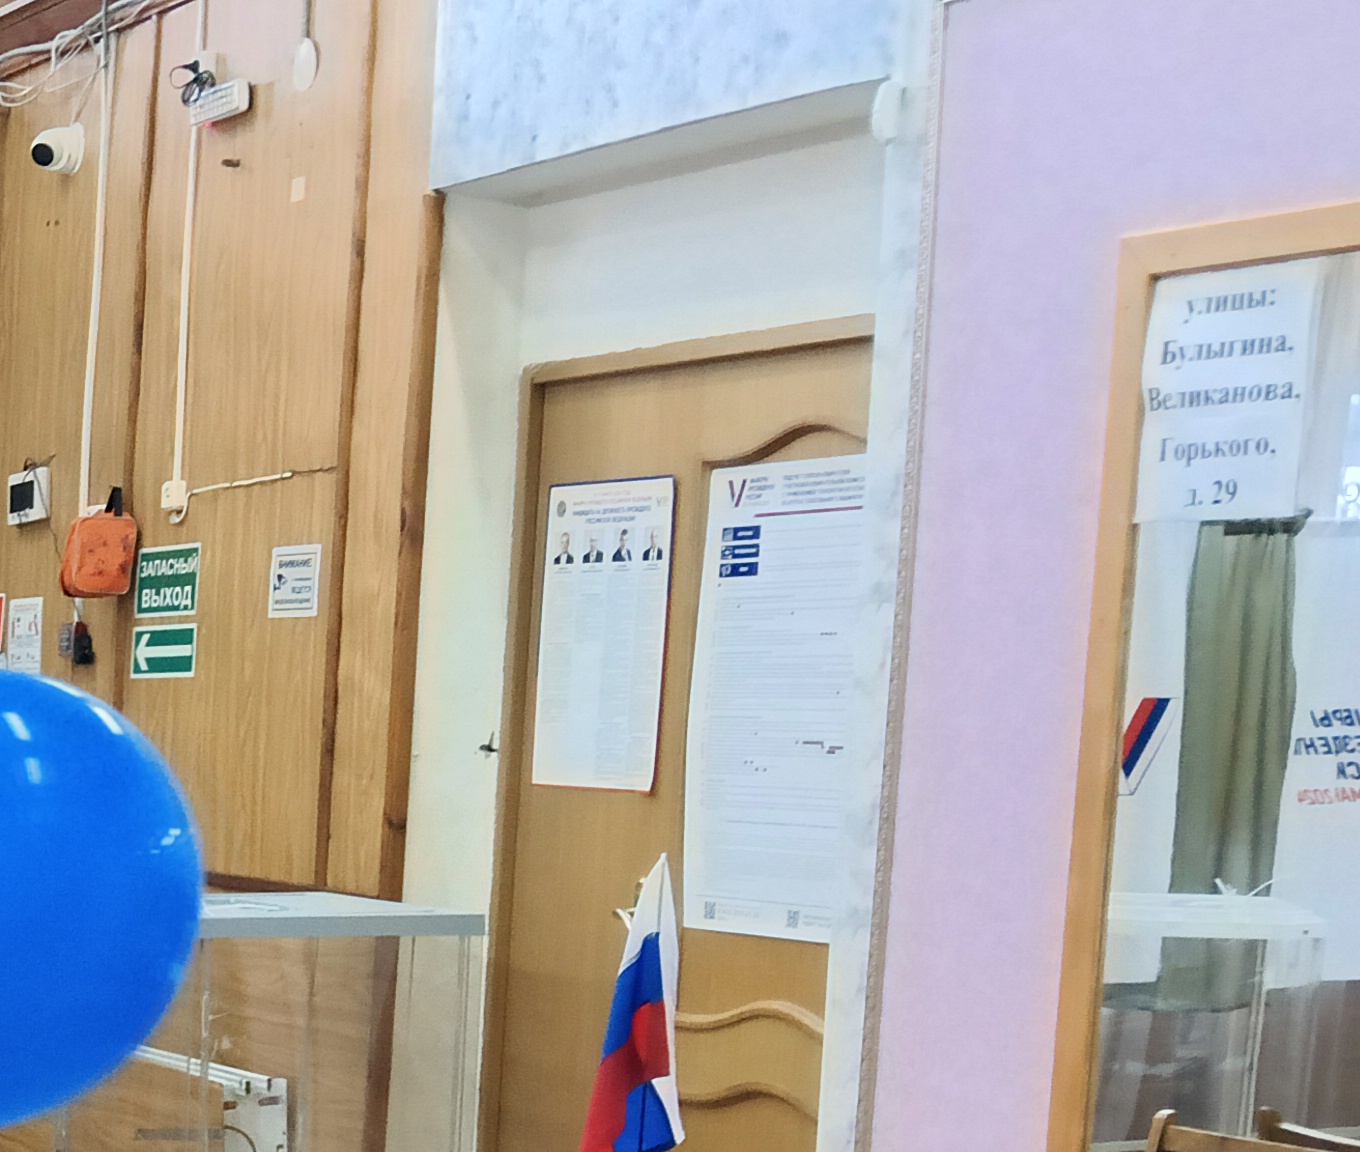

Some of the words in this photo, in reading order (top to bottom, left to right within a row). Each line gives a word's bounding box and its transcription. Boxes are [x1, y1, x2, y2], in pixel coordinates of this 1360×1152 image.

[1183, 288, 1277, 324] улицы:
[1211, 479, 1238, 505] 29
[139, 552, 199, 578] ЗАПАСНЫЙ
[141, 585, 193, 610] ВЫХОД
